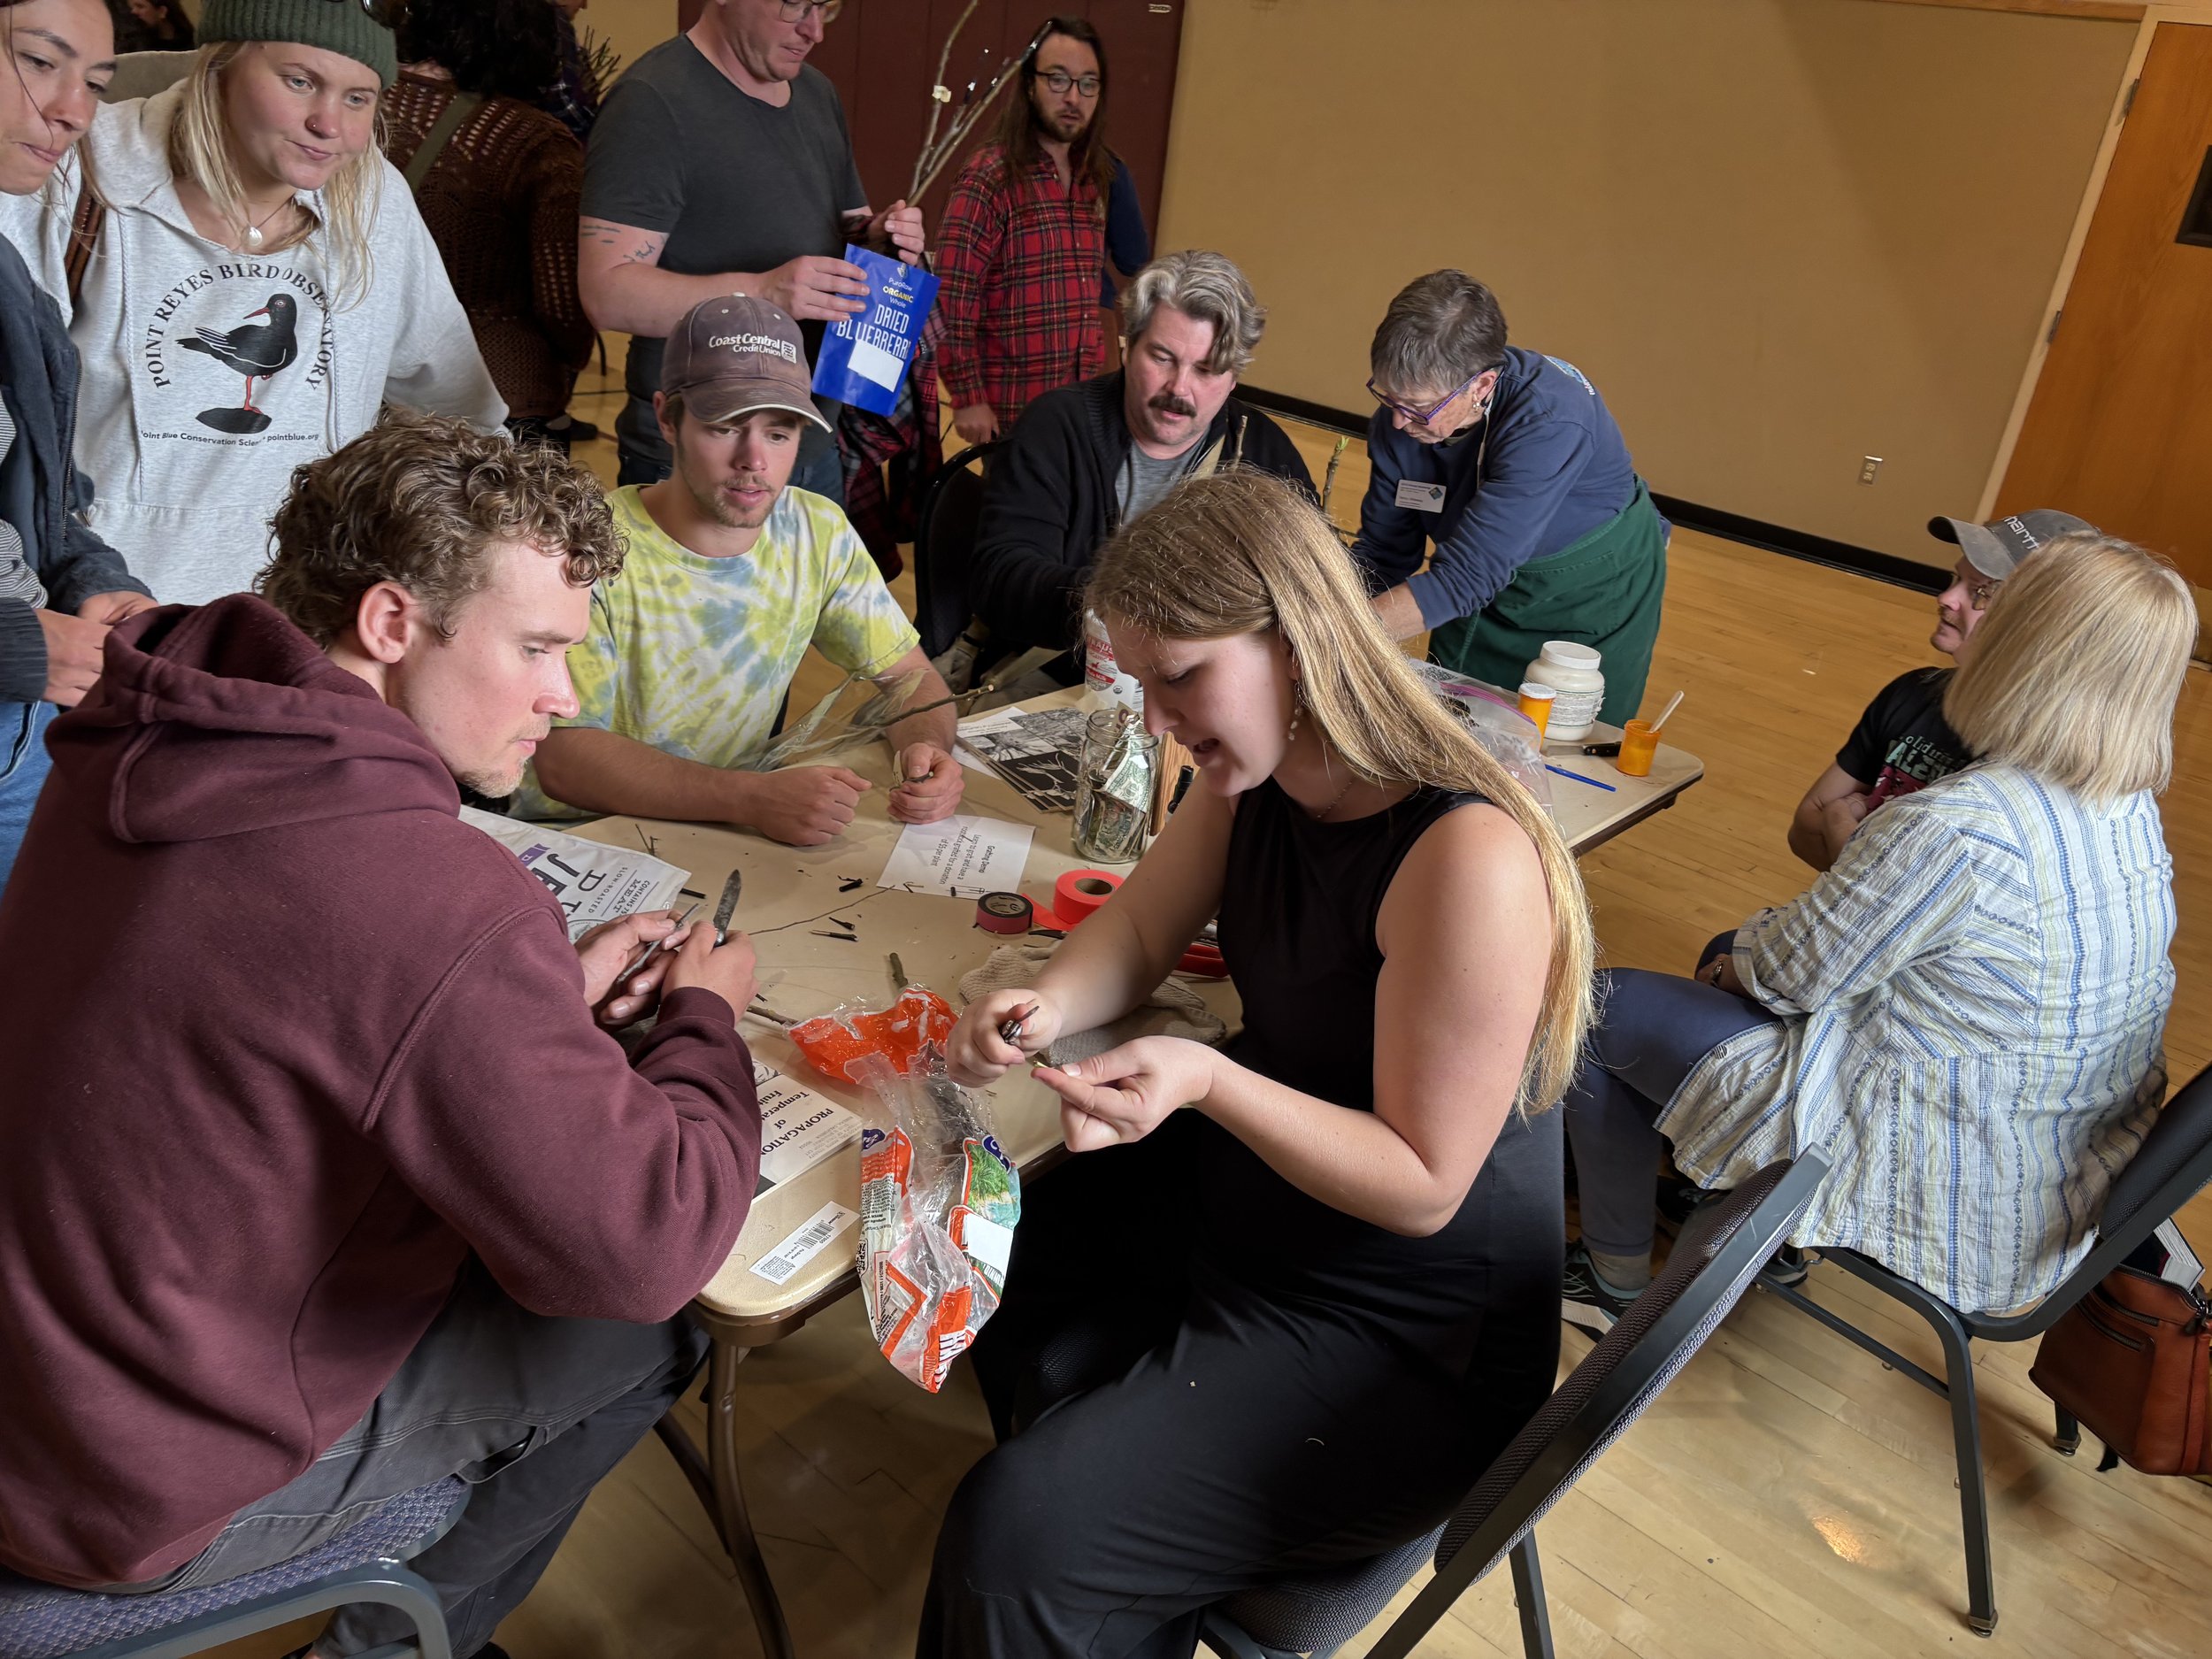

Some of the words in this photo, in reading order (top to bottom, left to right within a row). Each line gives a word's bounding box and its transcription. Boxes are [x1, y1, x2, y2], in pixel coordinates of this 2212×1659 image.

[219, 263, 280, 280] BIRD
[154, 269, 213, 323] REYES
[883, 286, 914, 303] ORGANIC
[282, 268, 334, 390] OBSEATORY
[874, 304, 910, 334] DRIED
[145, 325, 171, 388] POINT
[180, 433, 236, 445] Conservation
[979, 861, 989, 873] Demo
[981, 845, 995, 862] Grafting
[939, 866, 951, 885] donation
[588, 867, 628, 913] SLOW-ROASTED
[612, 879, 641, 913] MEAT
[627, 880, 650, 908] CONTAINS
[761, 1091, 809, 1120] Tempera
[773, 1119, 787, 1130] of
